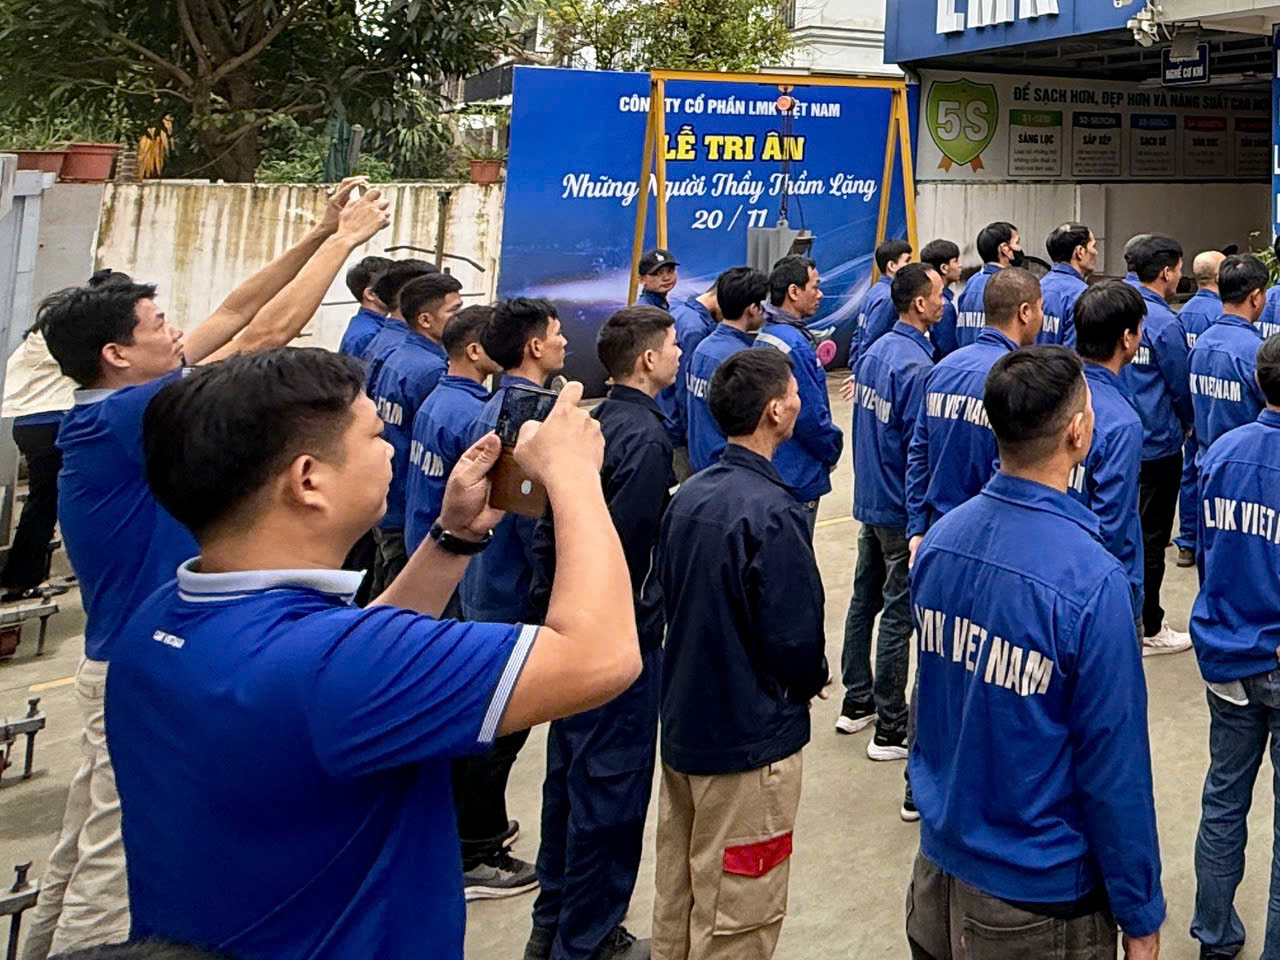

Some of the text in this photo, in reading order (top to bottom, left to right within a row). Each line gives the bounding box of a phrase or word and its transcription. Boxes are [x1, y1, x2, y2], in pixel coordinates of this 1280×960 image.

[620, 93, 650, 113] CÔN
[685, 93, 705, 114] CỔ
[707, 95, 744, 115] PHẦN
[749, 99, 777, 116] LMK
[810, 103, 841, 118] NAM
[1034, 87, 1067, 106] SẠCH
[936, 99, 990, 142] 5S
[704, 134, 756, 161] TRI
[761, 131, 806, 161] ÂN
[561, 172, 640, 207] Những
[711, 172, 765, 204] Thầy
[828, 175, 878, 203] Lặng
[691, 208, 724, 230] 20
[1203, 497, 1238, 531] LMK
[984, 635, 1055, 697] NAM
